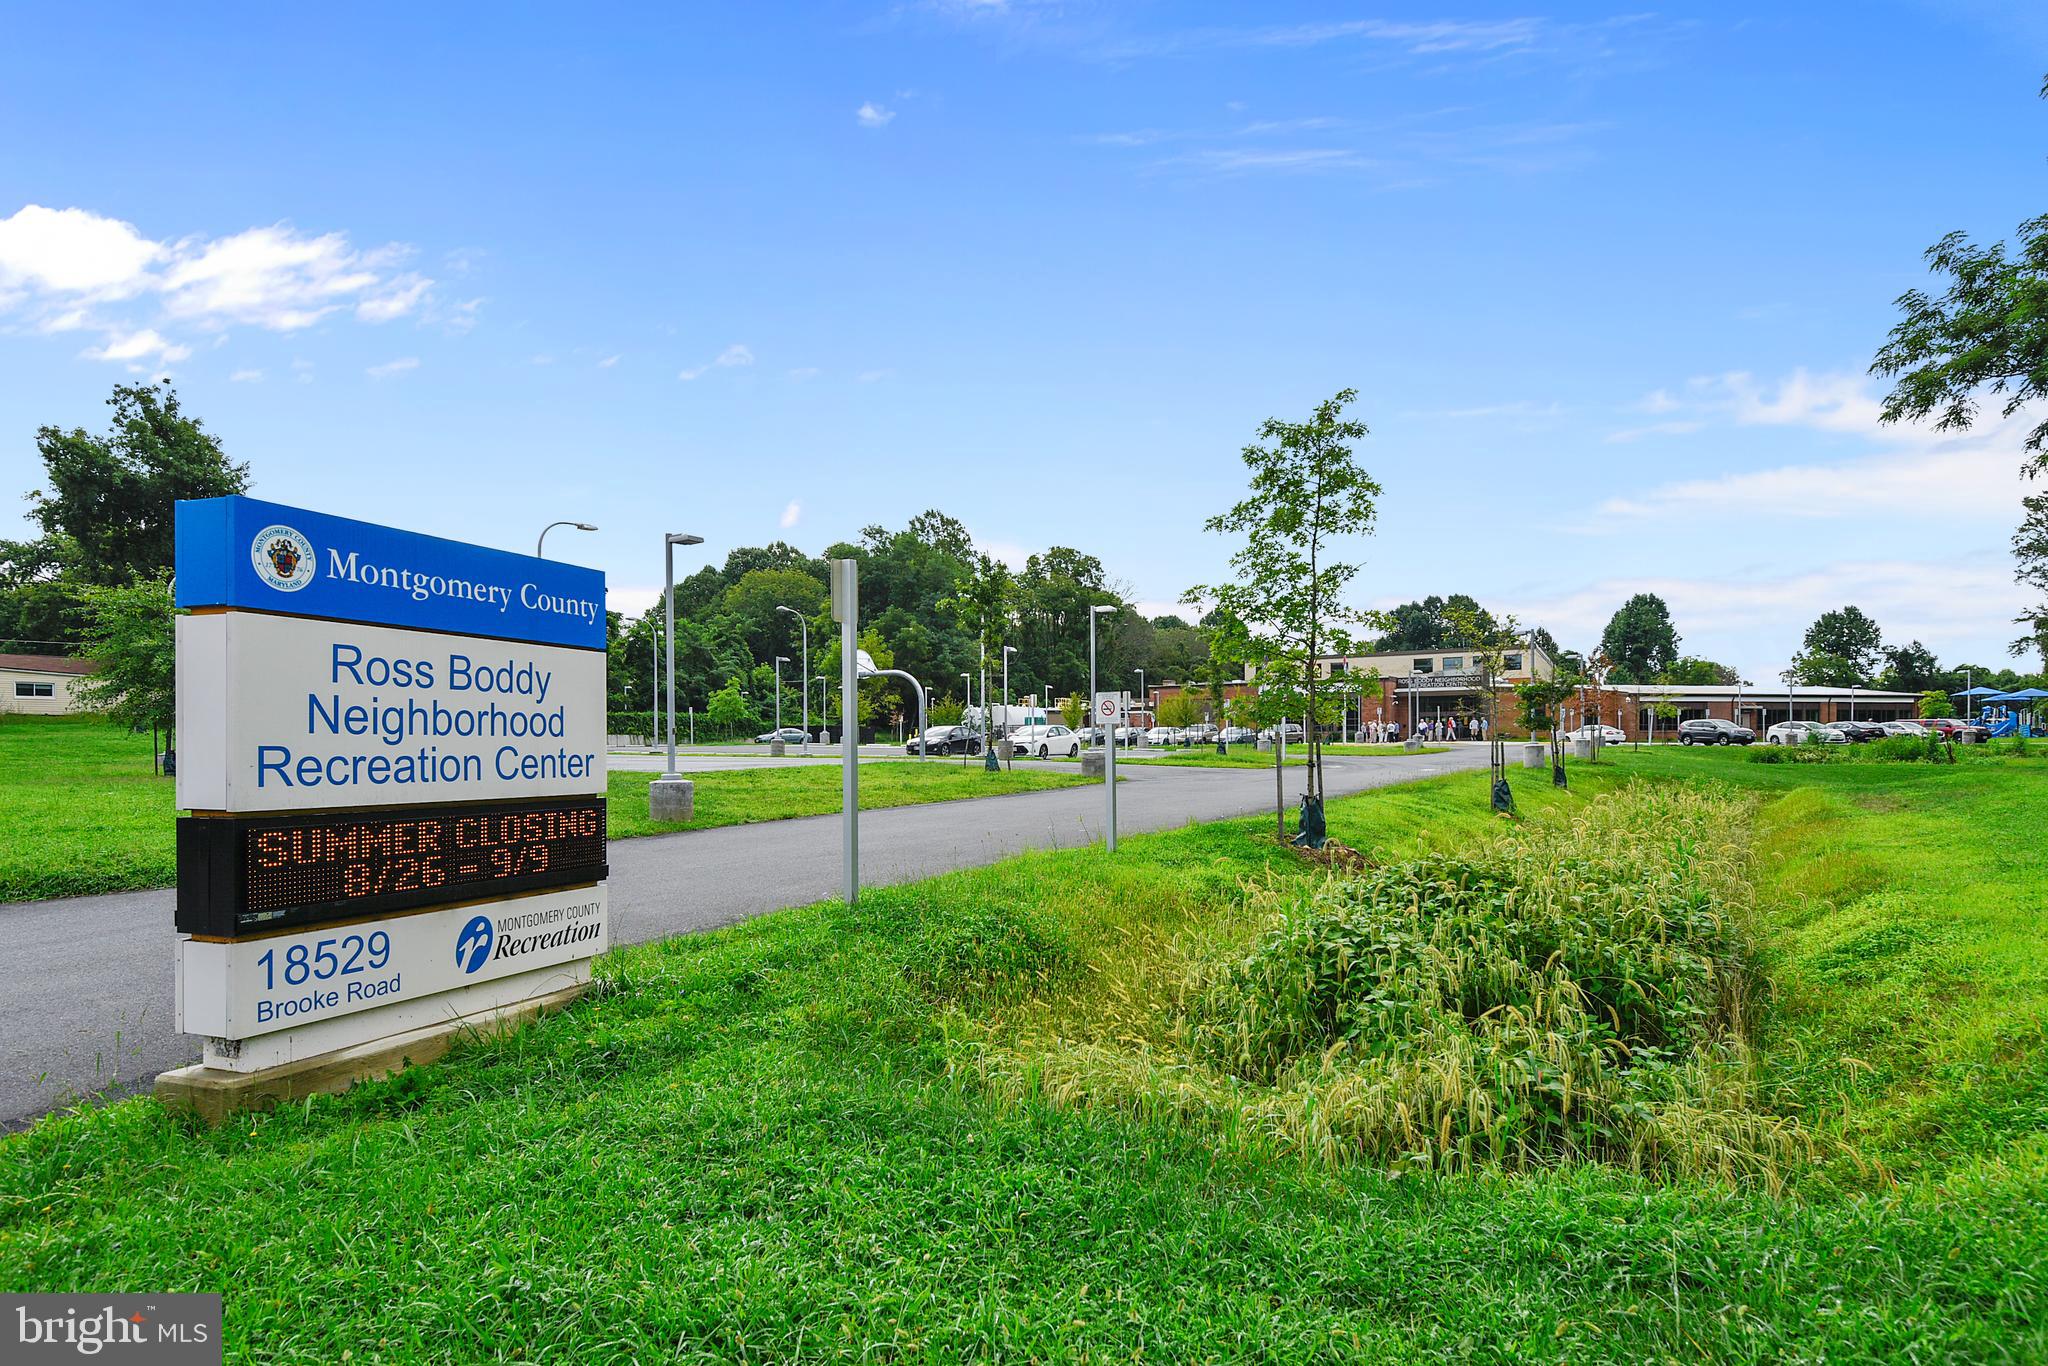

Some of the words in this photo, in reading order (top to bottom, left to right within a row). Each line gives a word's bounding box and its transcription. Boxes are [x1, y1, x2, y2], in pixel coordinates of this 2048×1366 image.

[254, 529, 293, 553] MONTGOMERY
[294, 535, 312, 560] COUNTY
[268, 576, 302, 588] MARYLAND
[326, 547, 512, 613] Montgomery
[519, 583, 599, 625] County
[331, 643, 434, 688] Ross
[449, 654, 552, 703] Boddy
[308, 693, 565, 746] Neighborhood
[257, 745, 482, 787] Recreation
[494, 745, 595, 782] Center
[258, 820, 442, 867] SUMMER
[455, 809, 597, 848] CLOSING
[344, 856, 446, 897] 8/26
[490, 845, 549, 877] 9/9
[493, 921, 601, 961] Recreation
[497, 909, 564, 933] MONTGOMERY
[566, 902, 601, 920] COUNTY
[257, 931, 391, 990] 18529
[257, 991, 338, 1023] Brooke
[346, 973, 401, 1000] Road
